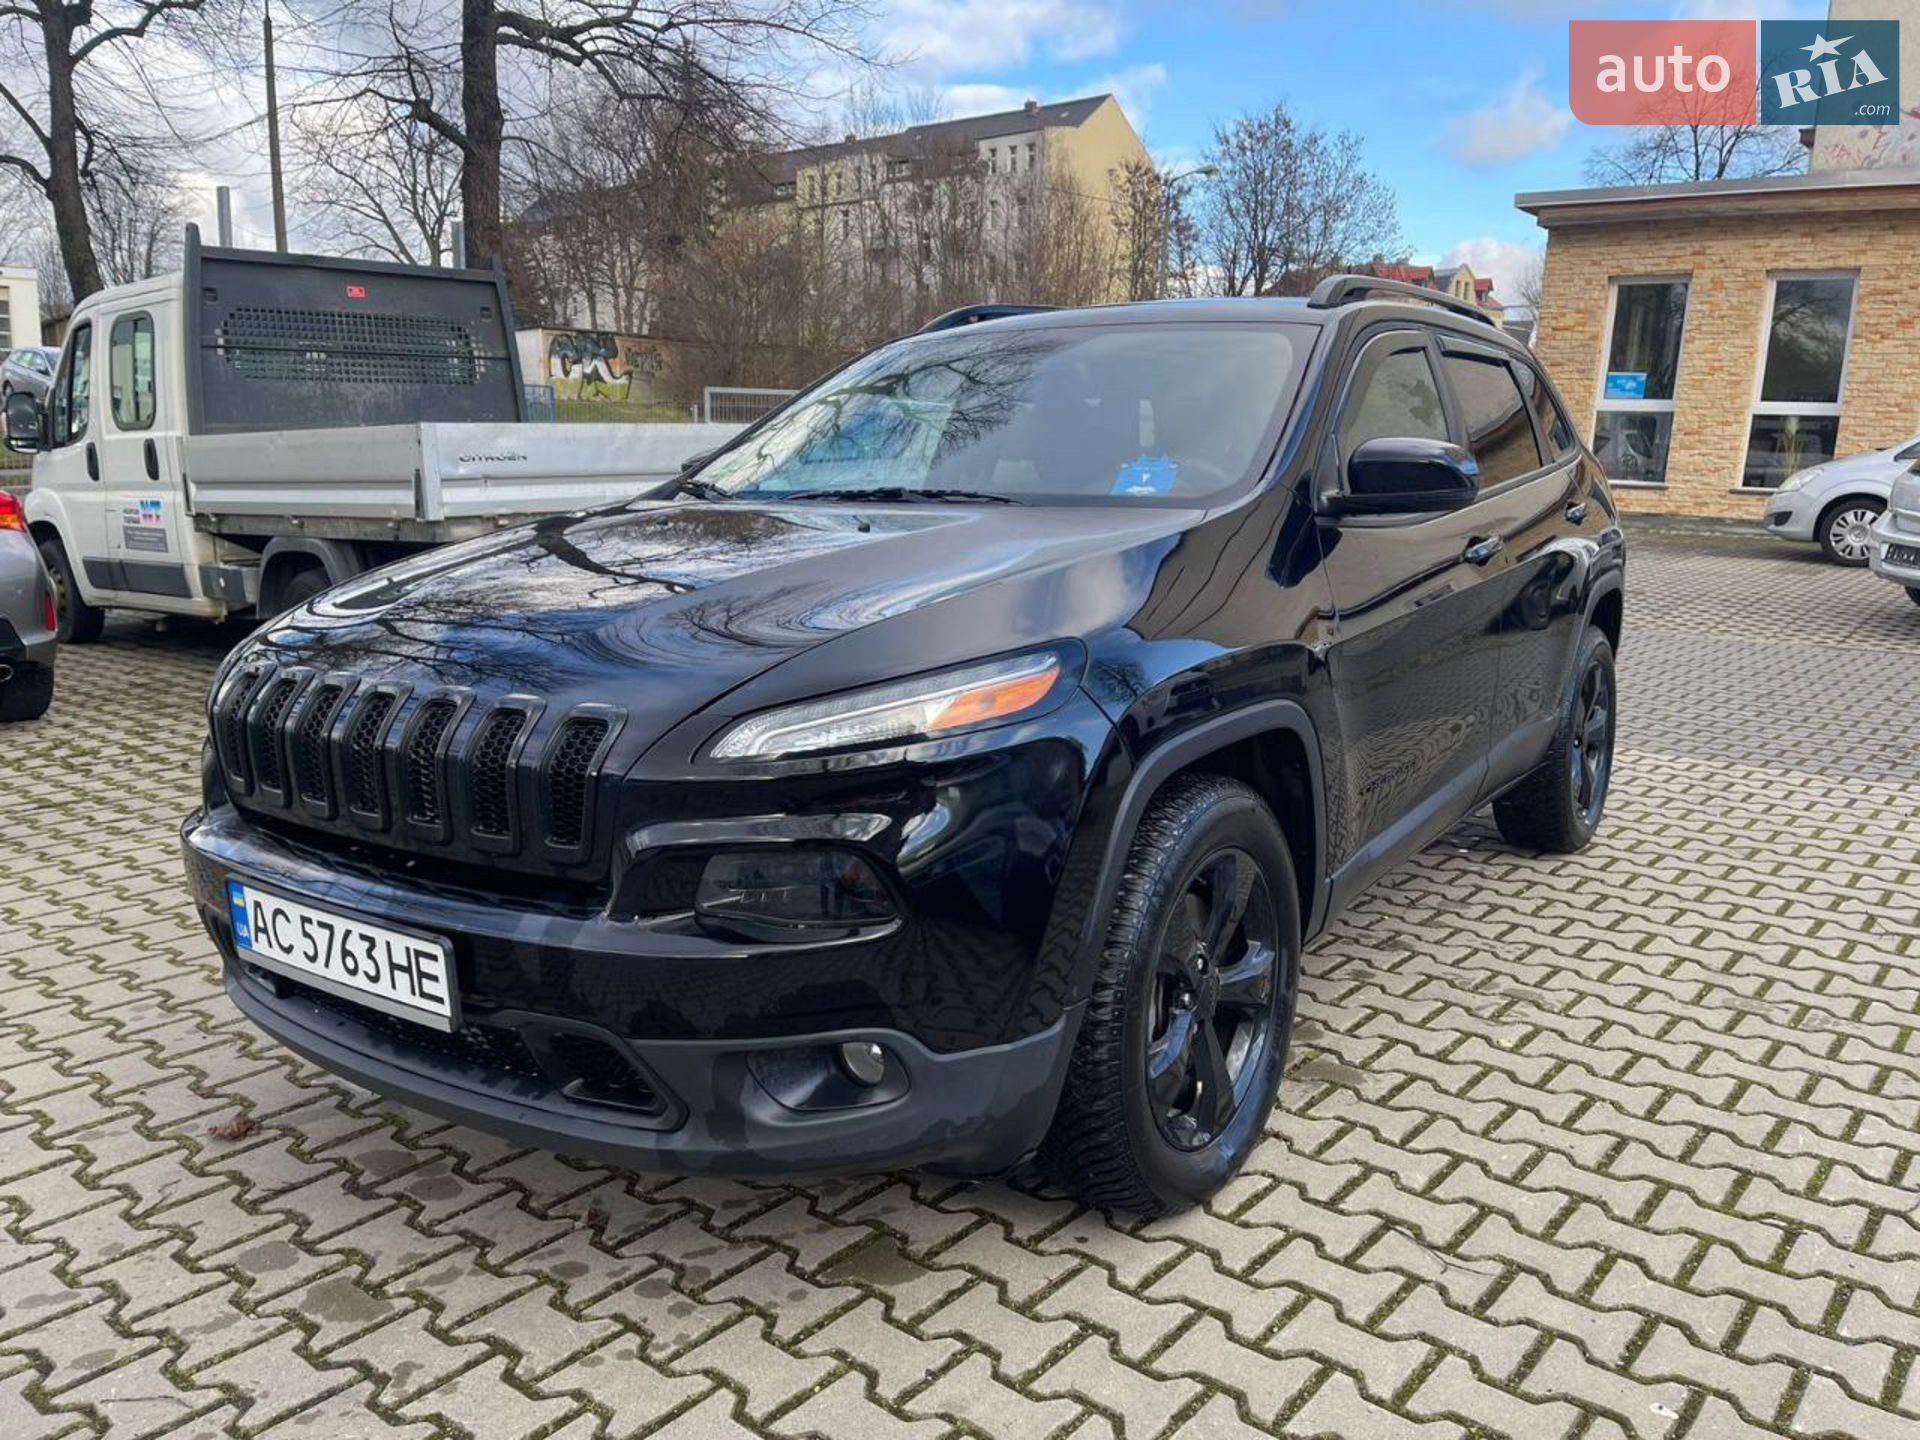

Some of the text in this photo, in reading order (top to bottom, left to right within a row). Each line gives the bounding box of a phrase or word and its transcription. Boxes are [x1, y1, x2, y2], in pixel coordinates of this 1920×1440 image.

[253, 899, 445, 1005] AC 5763 HE
